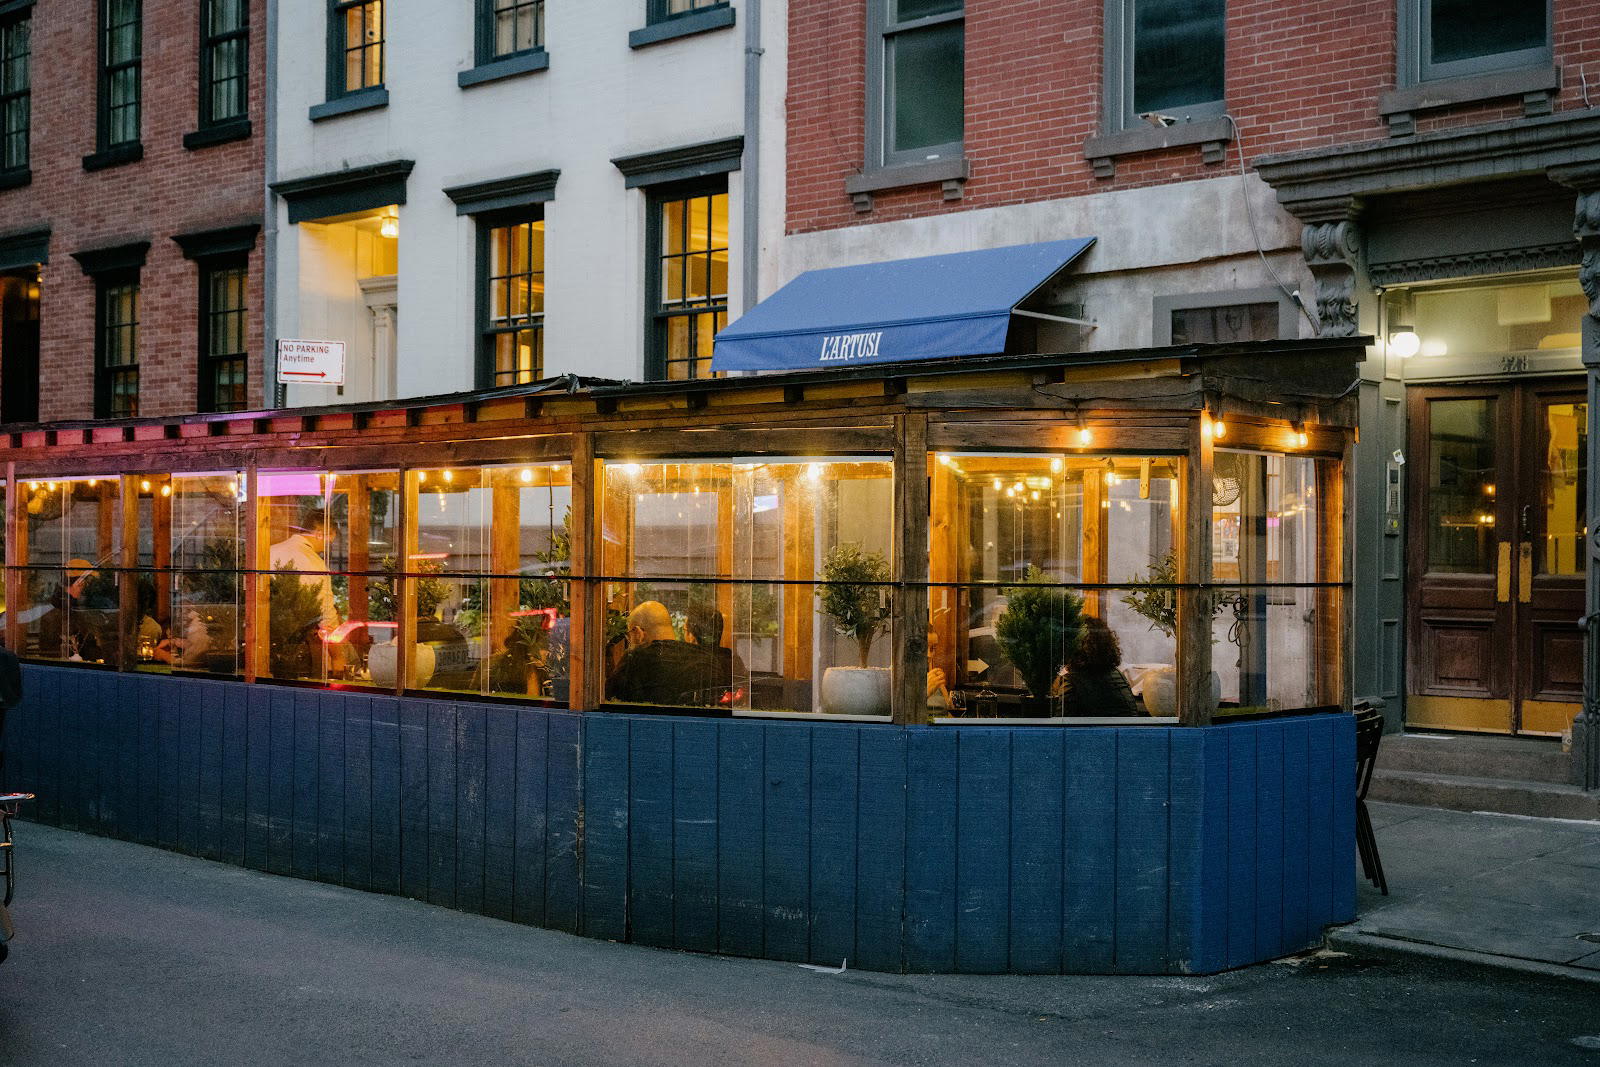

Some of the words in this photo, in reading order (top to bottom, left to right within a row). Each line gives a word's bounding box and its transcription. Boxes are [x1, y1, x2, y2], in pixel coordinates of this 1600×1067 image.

[283, 344, 294, 352] NO
[296, 344, 329, 354] PARKING
[820, 332, 882, 360] L'ARTUSI
[283, 354, 315, 363] Anytime
